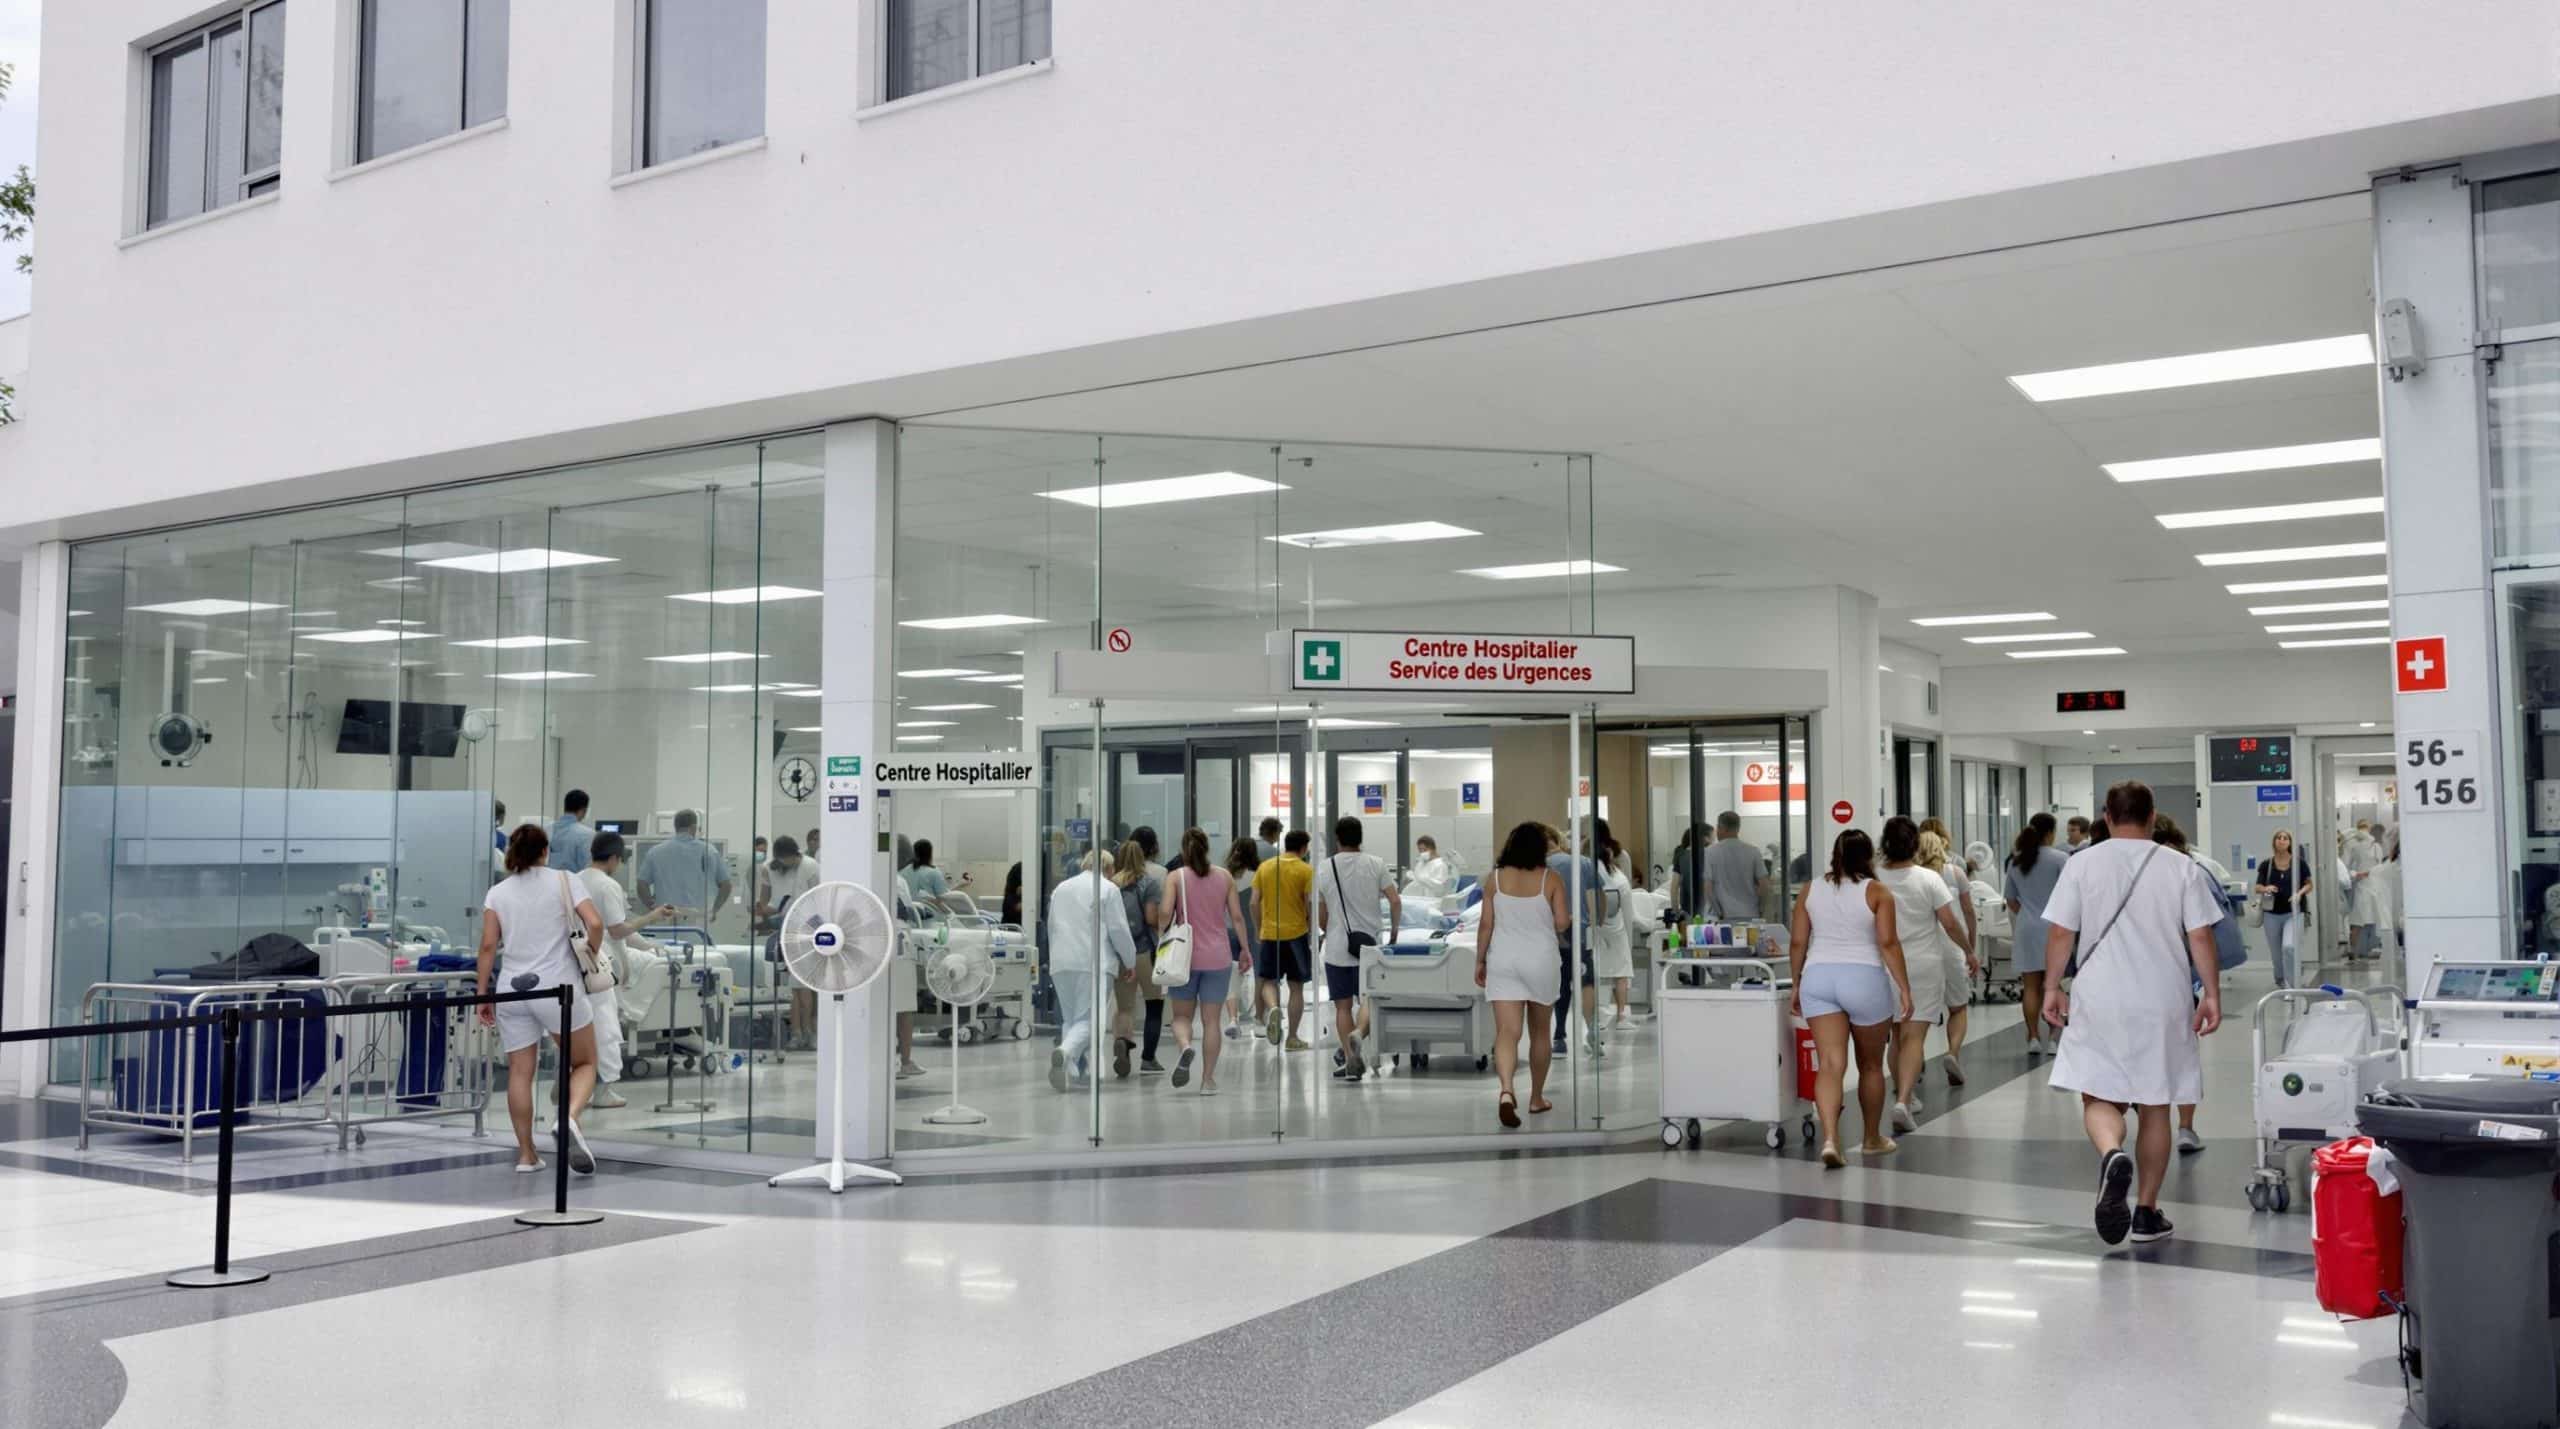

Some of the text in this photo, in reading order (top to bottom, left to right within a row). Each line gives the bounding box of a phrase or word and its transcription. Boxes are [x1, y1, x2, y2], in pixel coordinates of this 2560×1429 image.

[1405, 638, 1578, 661] Centre Hospitalier
[1389, 660, 1593, 685] Service des Urgences
[2407, 739, 2464, 767] 56-
[875, 763, 931, 781] Centre
[936, 762, 1032, 784] Hospitallier
[2414, 777, 2477, 806] 156
